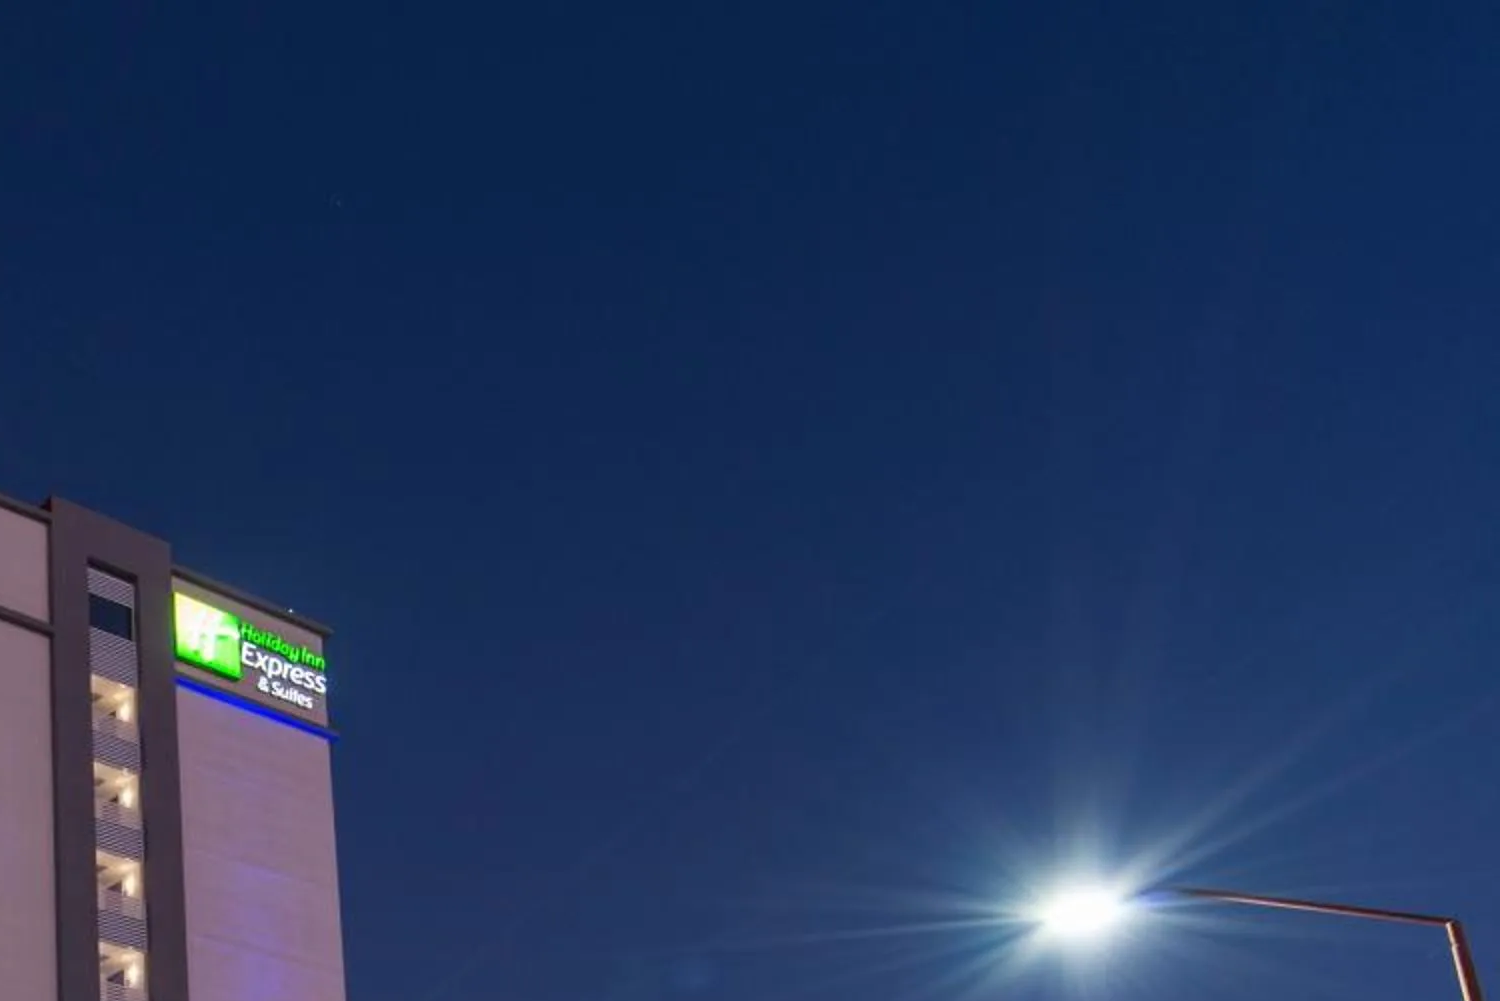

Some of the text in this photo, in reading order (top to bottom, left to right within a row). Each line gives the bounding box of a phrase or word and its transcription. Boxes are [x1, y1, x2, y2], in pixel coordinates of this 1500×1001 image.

[241, 622, 325, 672] Holiday Inn
[241, 640, 327, 694] Express
[257, 675, 313, 709] & Suites
